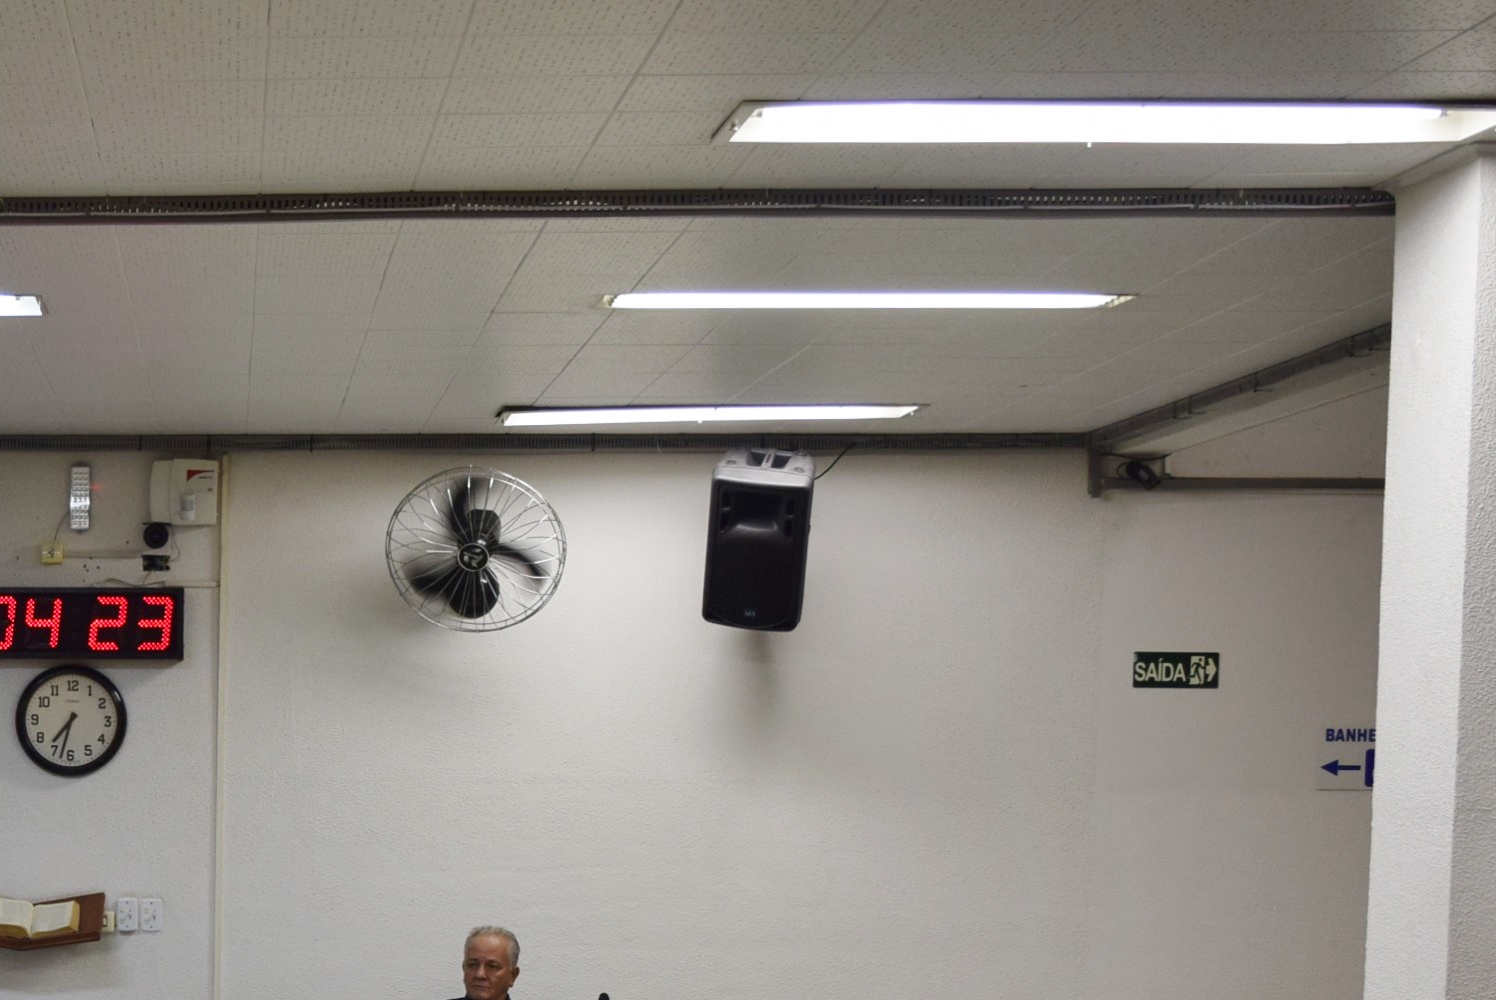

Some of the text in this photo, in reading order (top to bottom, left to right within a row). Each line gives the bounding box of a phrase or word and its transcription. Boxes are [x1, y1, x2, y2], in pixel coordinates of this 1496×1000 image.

[87, 595, 174, 651] 23
[1134, 657, 1186, 682] SAÍDA
[50, 685, 59, 696] 11
[67, 680, 79, 692] 12
[87, 685, 92, 696] 1
[38, 696, 50, 708] 10
[98, 697, 106, 709] 2
[31, 714, 39, 725] 9
[104, 715, 111, 727] 3
[36, 731, 44, 743] 8
[97, 734, 105, 744] 4
[51, 744, 58, 756] 7
[66, 749, 74, 761] 6
[84, 744, 92, 756] 5
